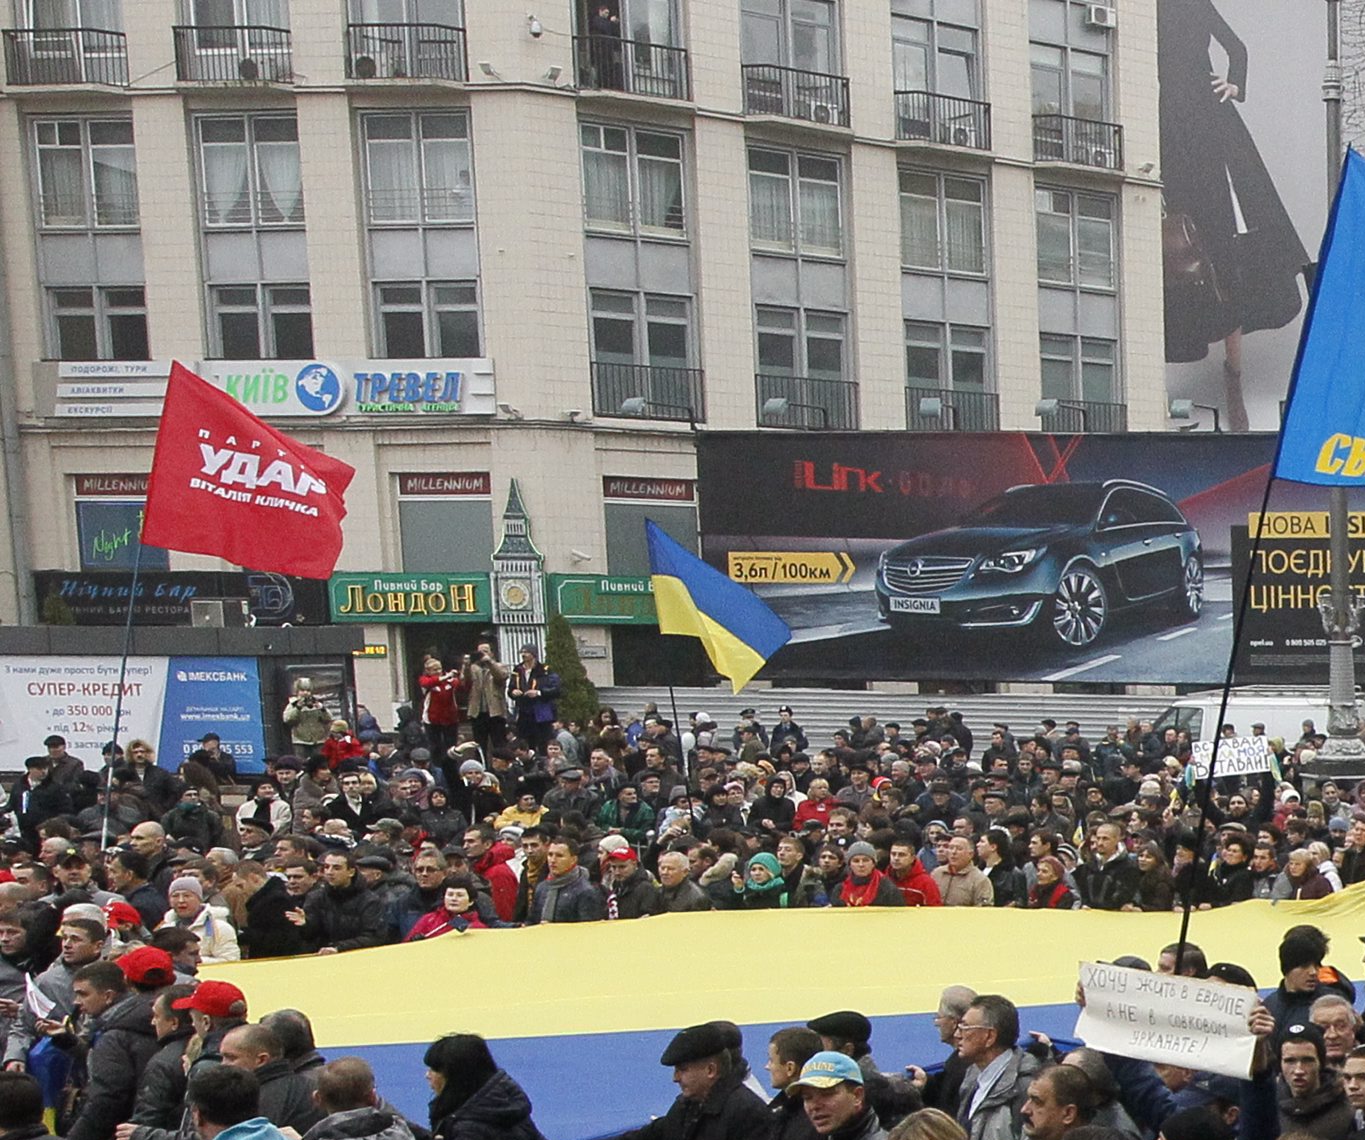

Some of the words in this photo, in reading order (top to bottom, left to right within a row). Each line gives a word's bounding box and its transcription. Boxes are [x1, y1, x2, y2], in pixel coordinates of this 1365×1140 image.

[124, 365, 148, 374] ТУРИ
[71, 386, 124, 395] АВІАКВИТКИ
[225, 367, 289, 404] КИЇВ
[354, 372, 462, 402] ТРЕВЕЛ
[199, 443, 328, 497] УДАР
[83, 478, 149, 491] MILLENNIU
[407, 478, 484, 492] MILLENNIUM
[609, 483, 686, 497] MILLENNIUM
[189, 477, 252, 503] ВІТАЛІЯ
[254, 495, 319, 518] КЛИЧКА
[1260, 516, 1316, 535] НОВА
[92, 527, 132, 561] Night
[734, 562, 768, 581] 3,6л
[781, 562, 831, 579] 100км
[59, 580, 144, 599] Нічний
[154, 581, 198, 603] Бар
[374, 578, 417, 591] Пивний
[420, 578, 443, 593] Бар
[601, 579, 645, 592] Пивний
[145, 606, 191, 615] РЕСТОРА
[893, 599, 937, 611] INSIGNIA
[12, 667, 37, 675] нами
[38, 667, 61, 677] дуже
[64, 667, 95, 678] просто
[97, 664, 119, 677] бути
[121, 665, 153, 678] упер!
[187, 671, 248, 682] ІМЕКСБАНК
[27, 682, 142, 700] СУПЕР-КРЕДИТ
[52, 708, 65, 718] до
[67, 705, 87, 716] 350
[91, 705, 113, 717] 000
[53, 721, 70, 734] під
[72, 721, 94, 733] 12%
[234, 744, 254, 755] 553
[1237, 744, 1266, 757] МОЯ
[1087, 967, 1128, 994] ХОЧУ
[1136, 976, 1176, 999] ЖИТЬ
[1181, 984, 1188, 1000] В
[1195, 987, 1247, 1020] ЕВРОПЕ,
[1148, 1008, 1157, 1026] В
[1167, 1012, 1229, 1039] СОВКОВОМ
[1128, 1030, 1209, 1059] УРКАНАТЕ!
